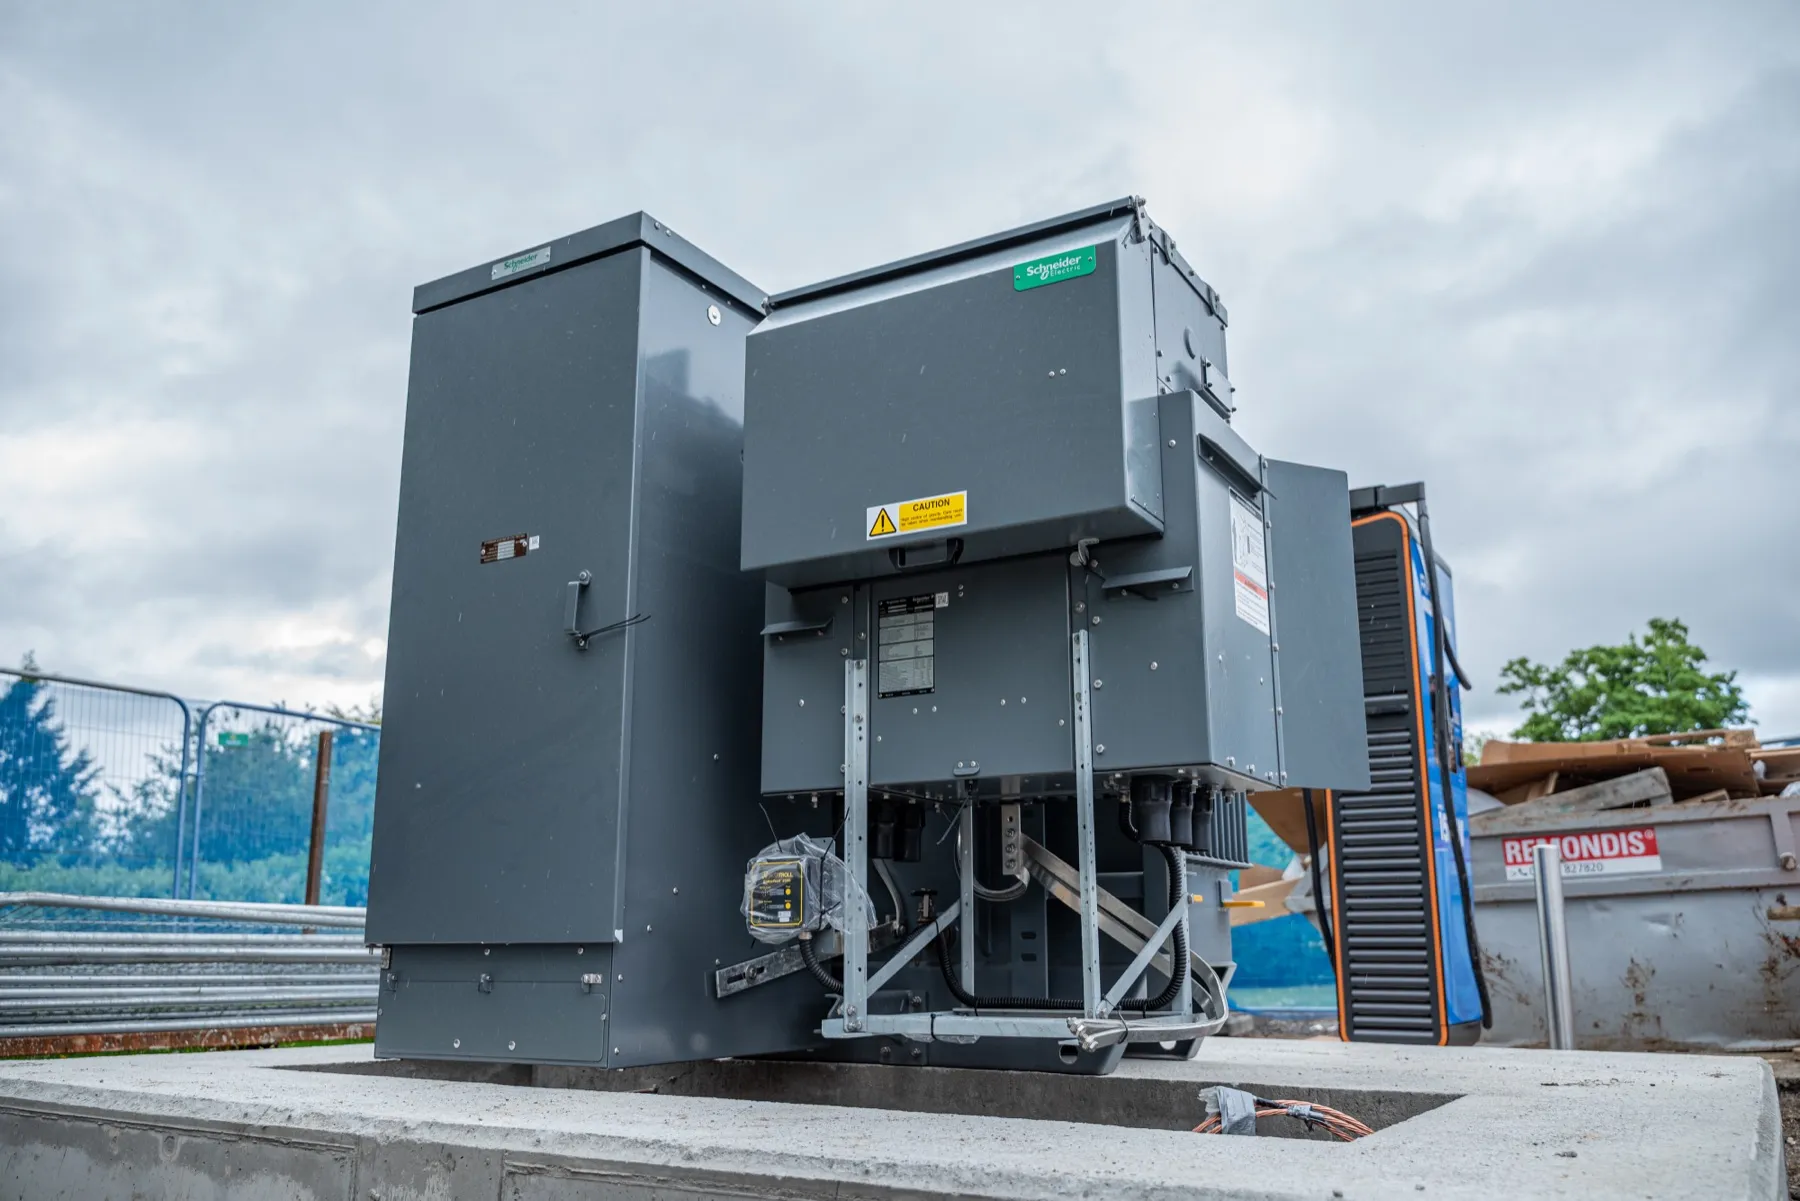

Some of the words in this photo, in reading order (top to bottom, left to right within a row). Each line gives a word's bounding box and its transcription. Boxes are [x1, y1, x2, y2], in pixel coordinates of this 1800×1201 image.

[1026, 256, 1081, 280] Schneider
[1050, 265, 1080, 277] Electric
[912, 499, 950, 512] CAUTION
